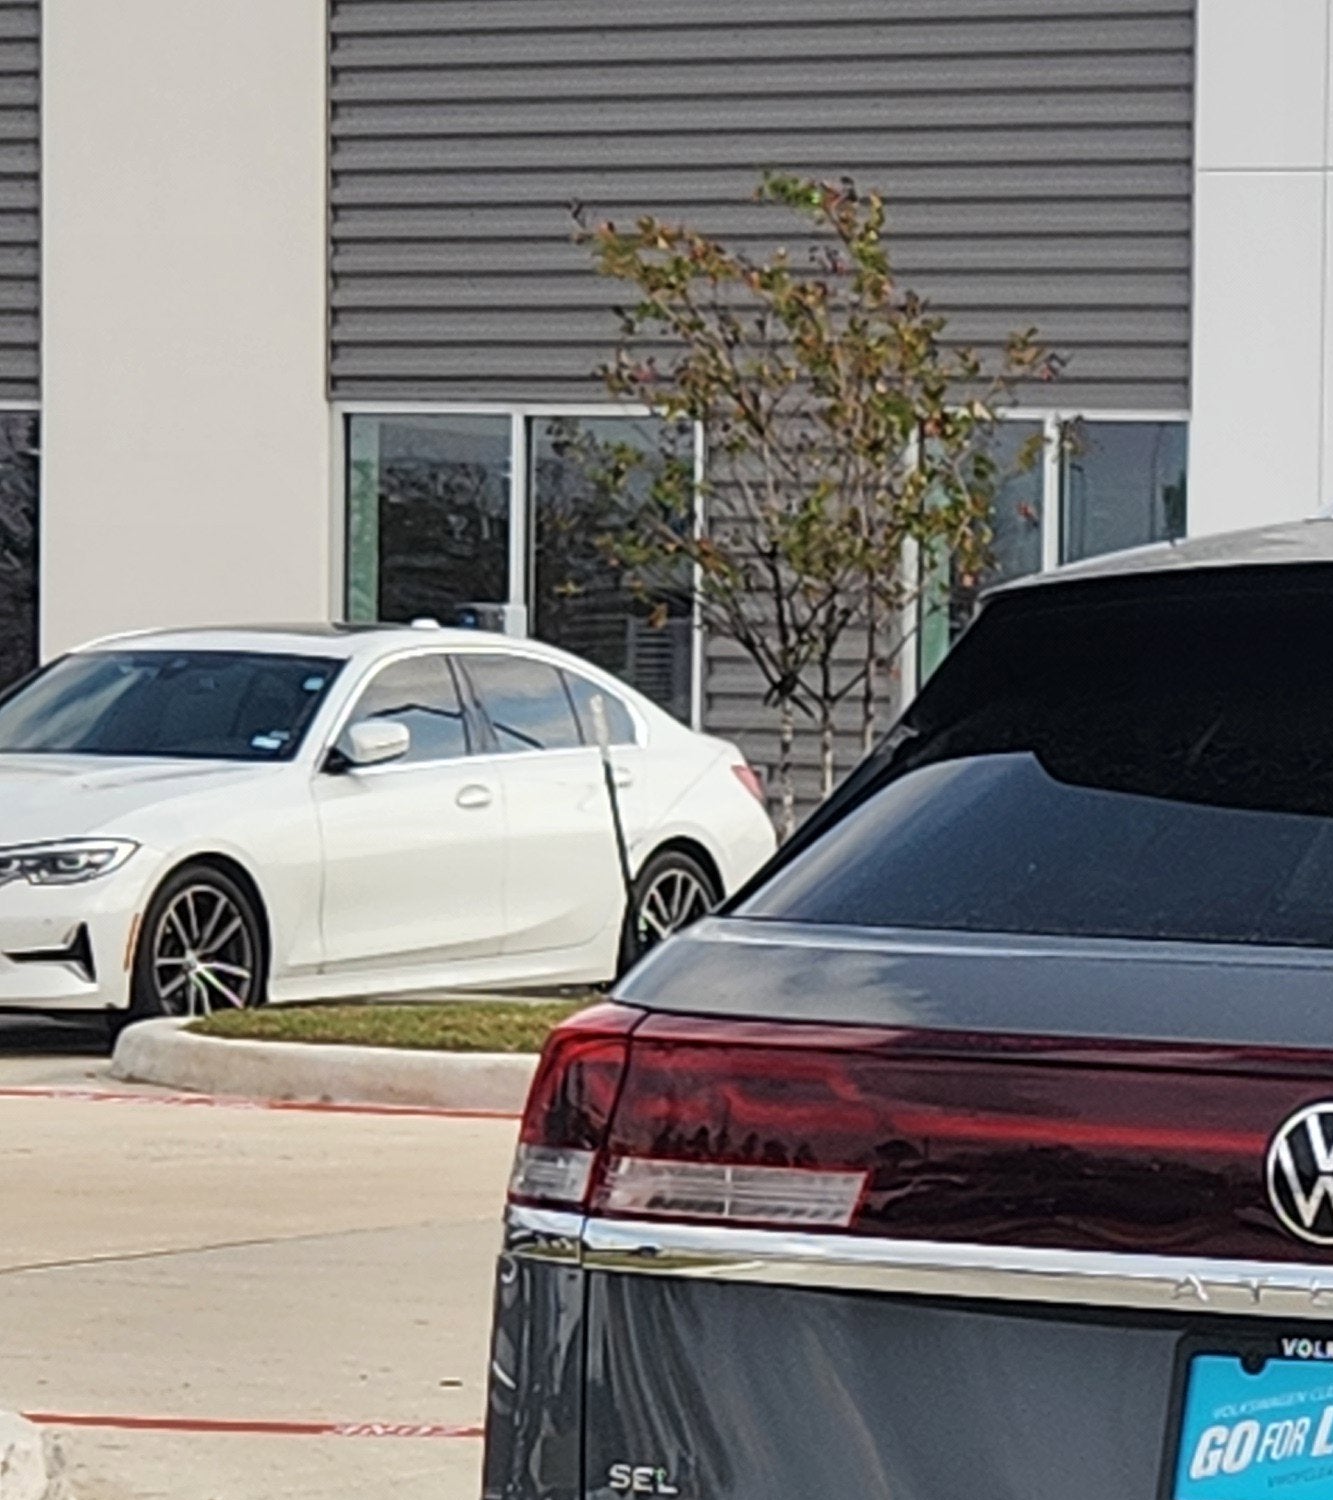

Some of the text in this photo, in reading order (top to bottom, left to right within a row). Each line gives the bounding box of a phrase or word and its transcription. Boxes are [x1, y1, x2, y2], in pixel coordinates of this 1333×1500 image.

[1190, 1420, 1261, 1480] GO
[1255, 1416, 1311, 1464] FOR
[608, 1463, 680, 1495] SEL
